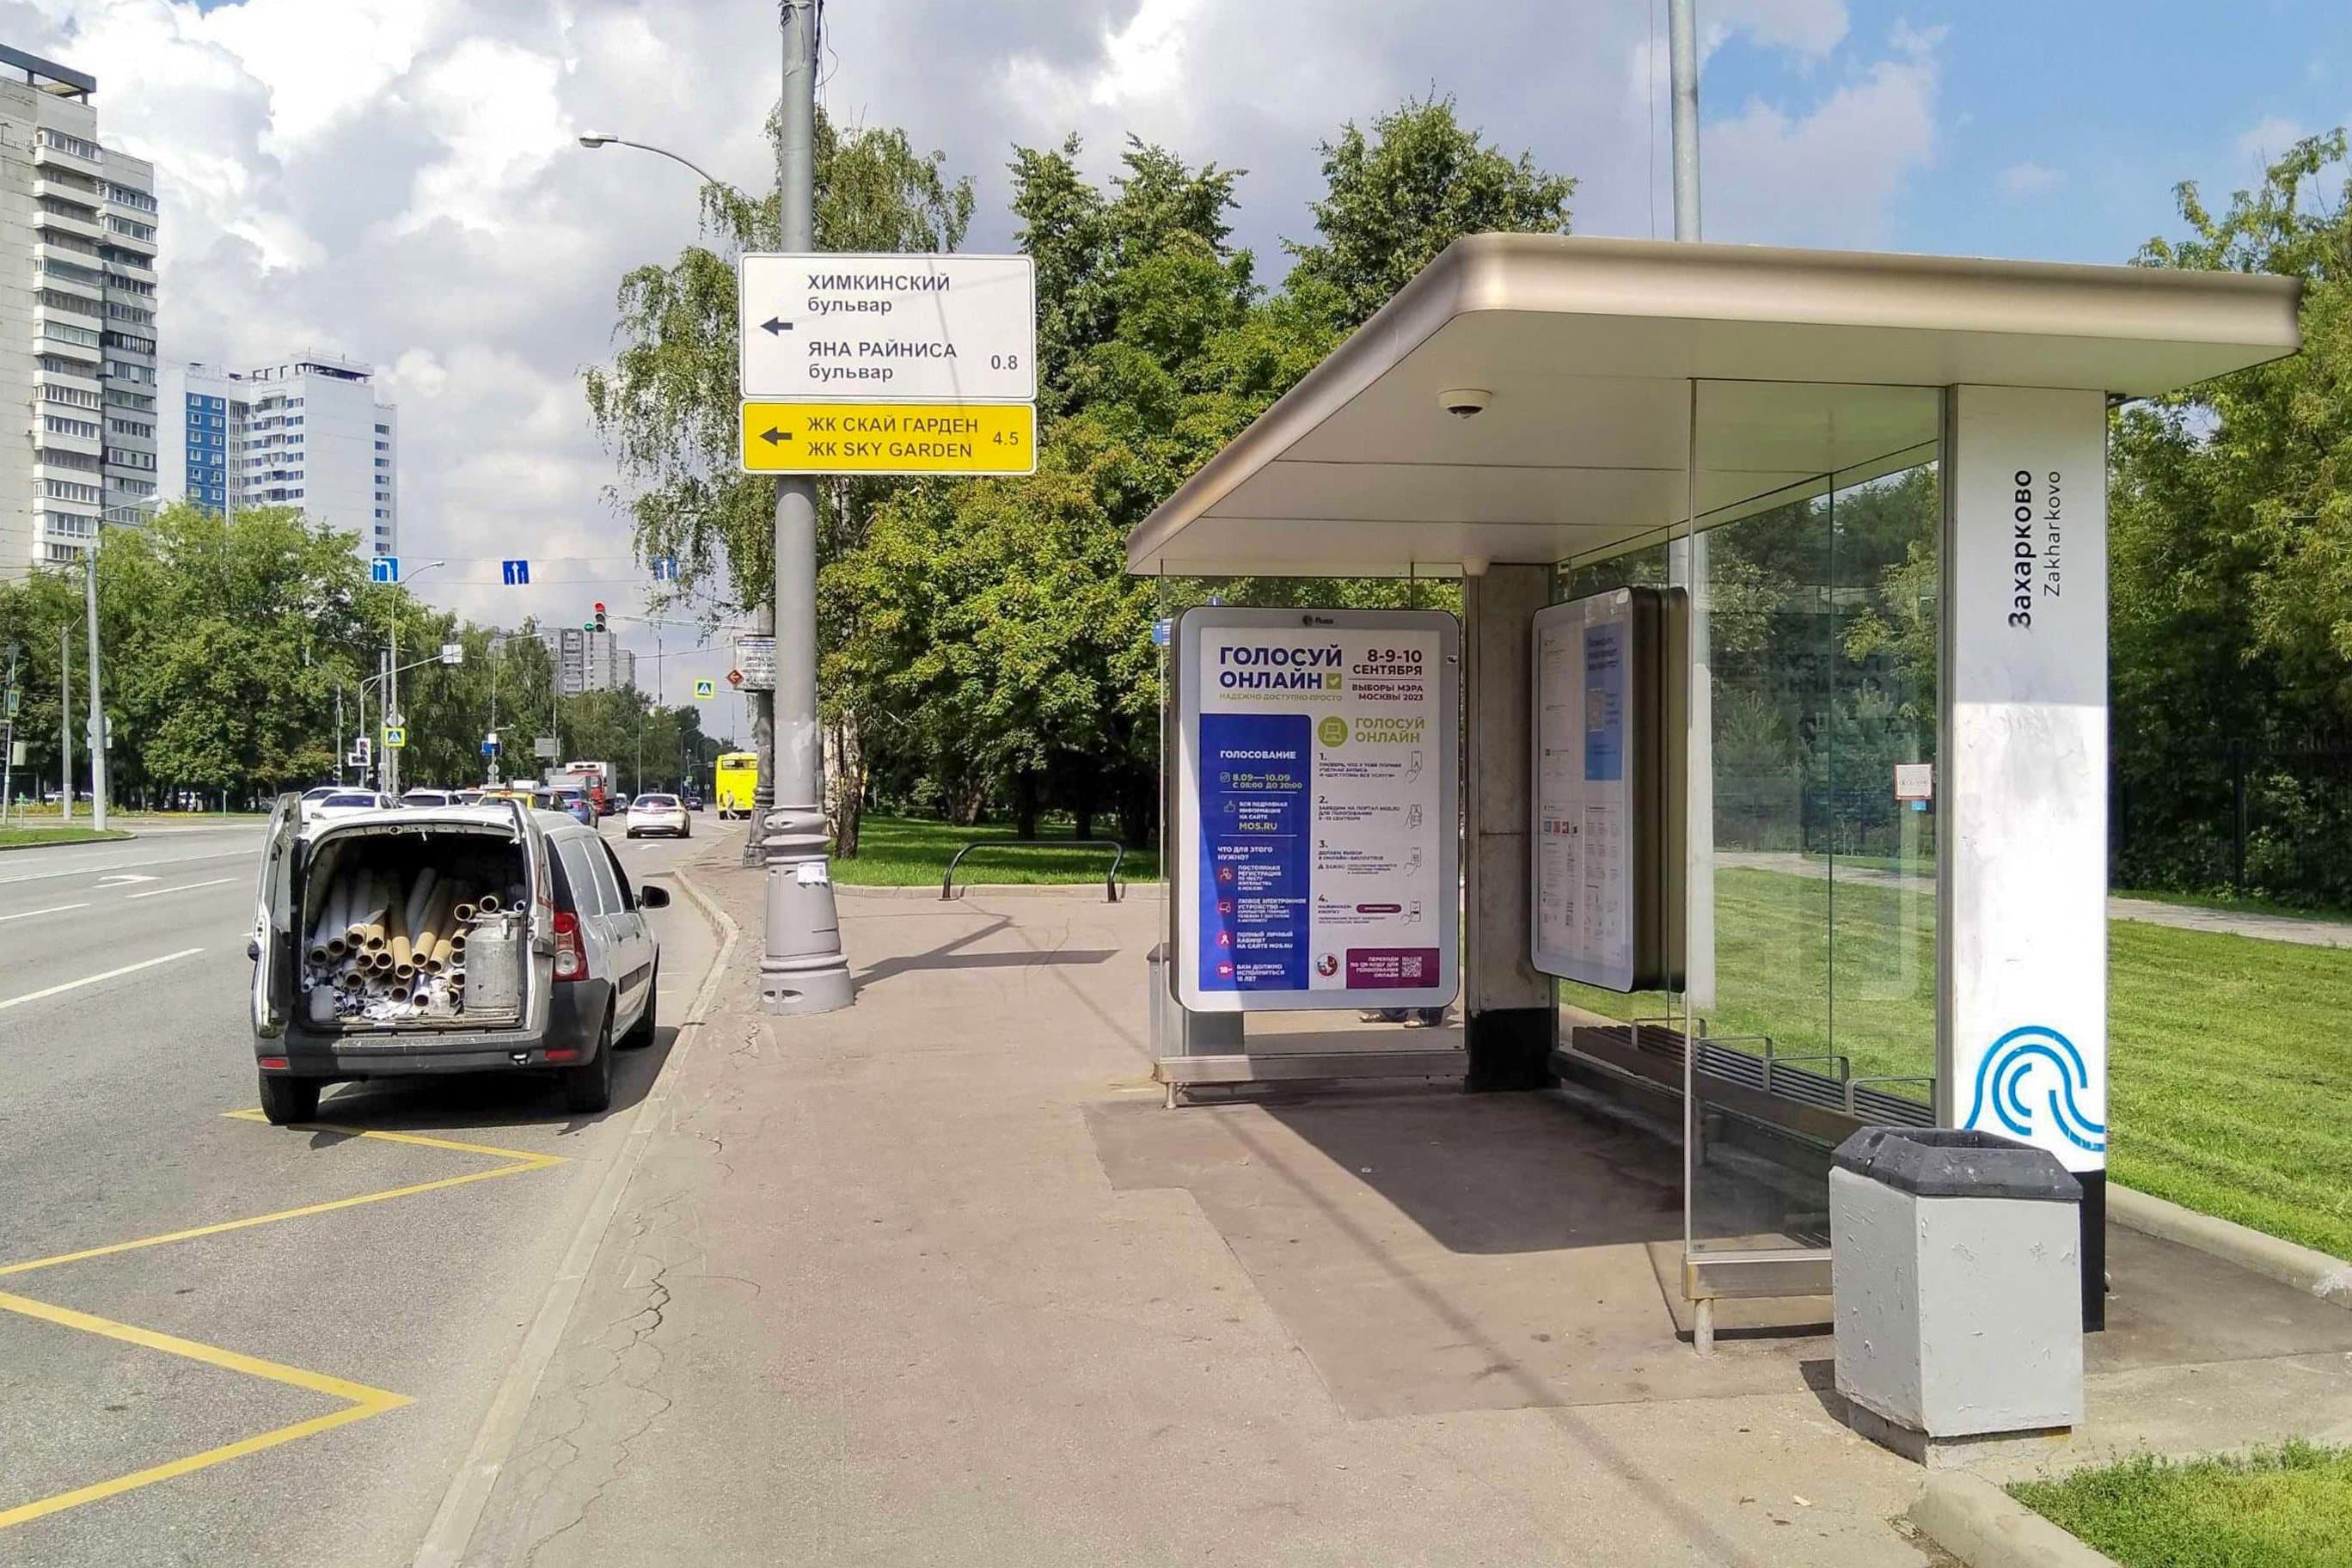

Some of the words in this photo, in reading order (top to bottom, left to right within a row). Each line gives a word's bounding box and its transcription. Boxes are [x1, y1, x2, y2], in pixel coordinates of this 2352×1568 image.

[807, 273, 950, 291] ХИМКИНСКИЙ
[808, 297, 892, 315] бульвар
[808, 341, 852, 357] ЯНА
[859, 340, 957, 358] РАЙНИСА
[990, 355, 1019, 370] 0.8
[809, 364, 893, 383] бульвар
[806, 417, 836, 432] ЖК
[842, 414, 897, 433] СКАЙ
[903, 418, 978, 436] ГАРДЕН
[992, 432, 1020, 446] 4.5
[807, 442, 837, 456] ЖК
[843, 442, 883, 457] SKY
[889, 442, 972, 458] GARDEN
[2043, 471, 2061, 597] Zakharkovo
[2008, 470, 2037, 632] Захарково
[1220, 644, 1342, 666] ГОЛОСУЙ
[1367, 649, 1423, 663] 8-9-10
[1219, 667, 1322, 689] ОНЛАЙН
[1352, 665, 1423, 676] СЕНТЯБРЯ
[1351, 683, 1394, 692] ВЫБОРЫ
[1355, 716, 1425, 729] ГОЛОСУЙ
[1355, 729, 1420, 743] ОНЛАЙН
[1220, 750, 1297, 759] ГОЛОСОВАНИЕ
[1238, 822, 1277, 830] MOS.RU
